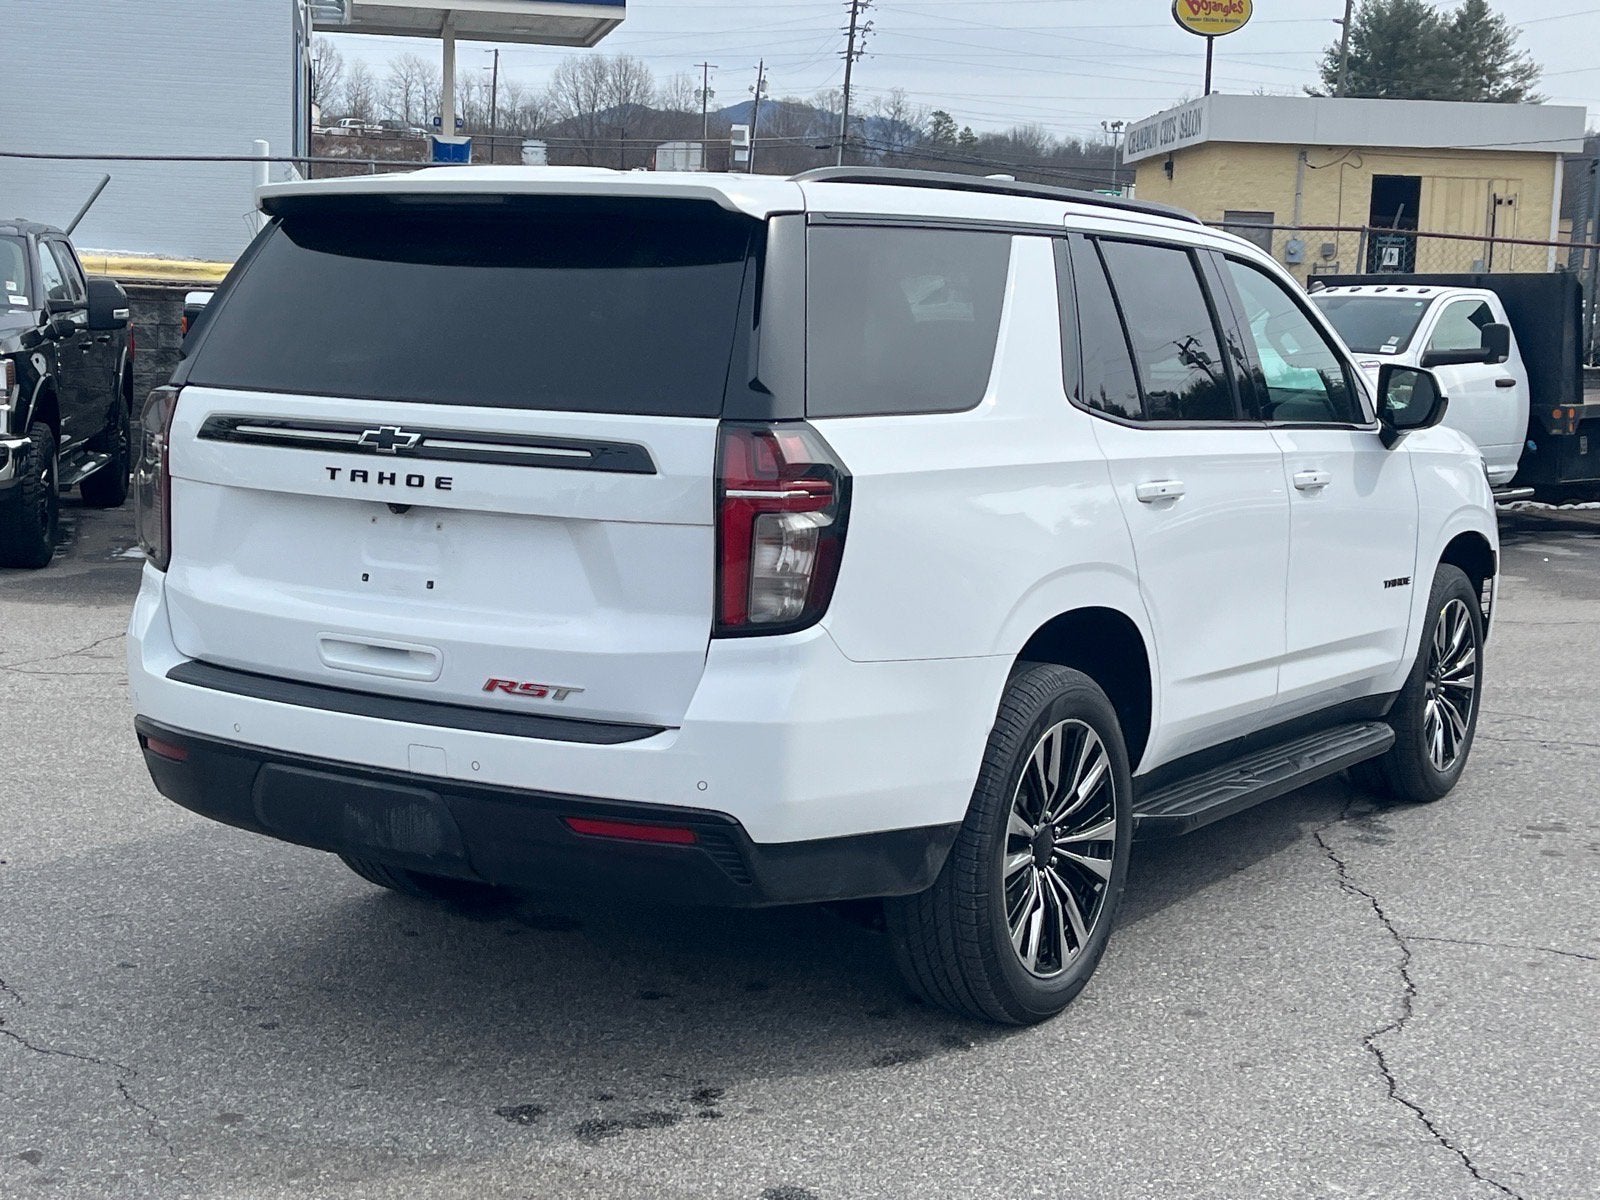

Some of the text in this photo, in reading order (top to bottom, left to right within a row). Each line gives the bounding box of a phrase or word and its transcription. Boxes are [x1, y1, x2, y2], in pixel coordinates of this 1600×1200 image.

[1179, 107, 1204, 140] SALON
[325, 466, 453, 491] TAHOE
[1383, 576, 1411, 589] TAHOE
[482, 677, 585, 701] RST
